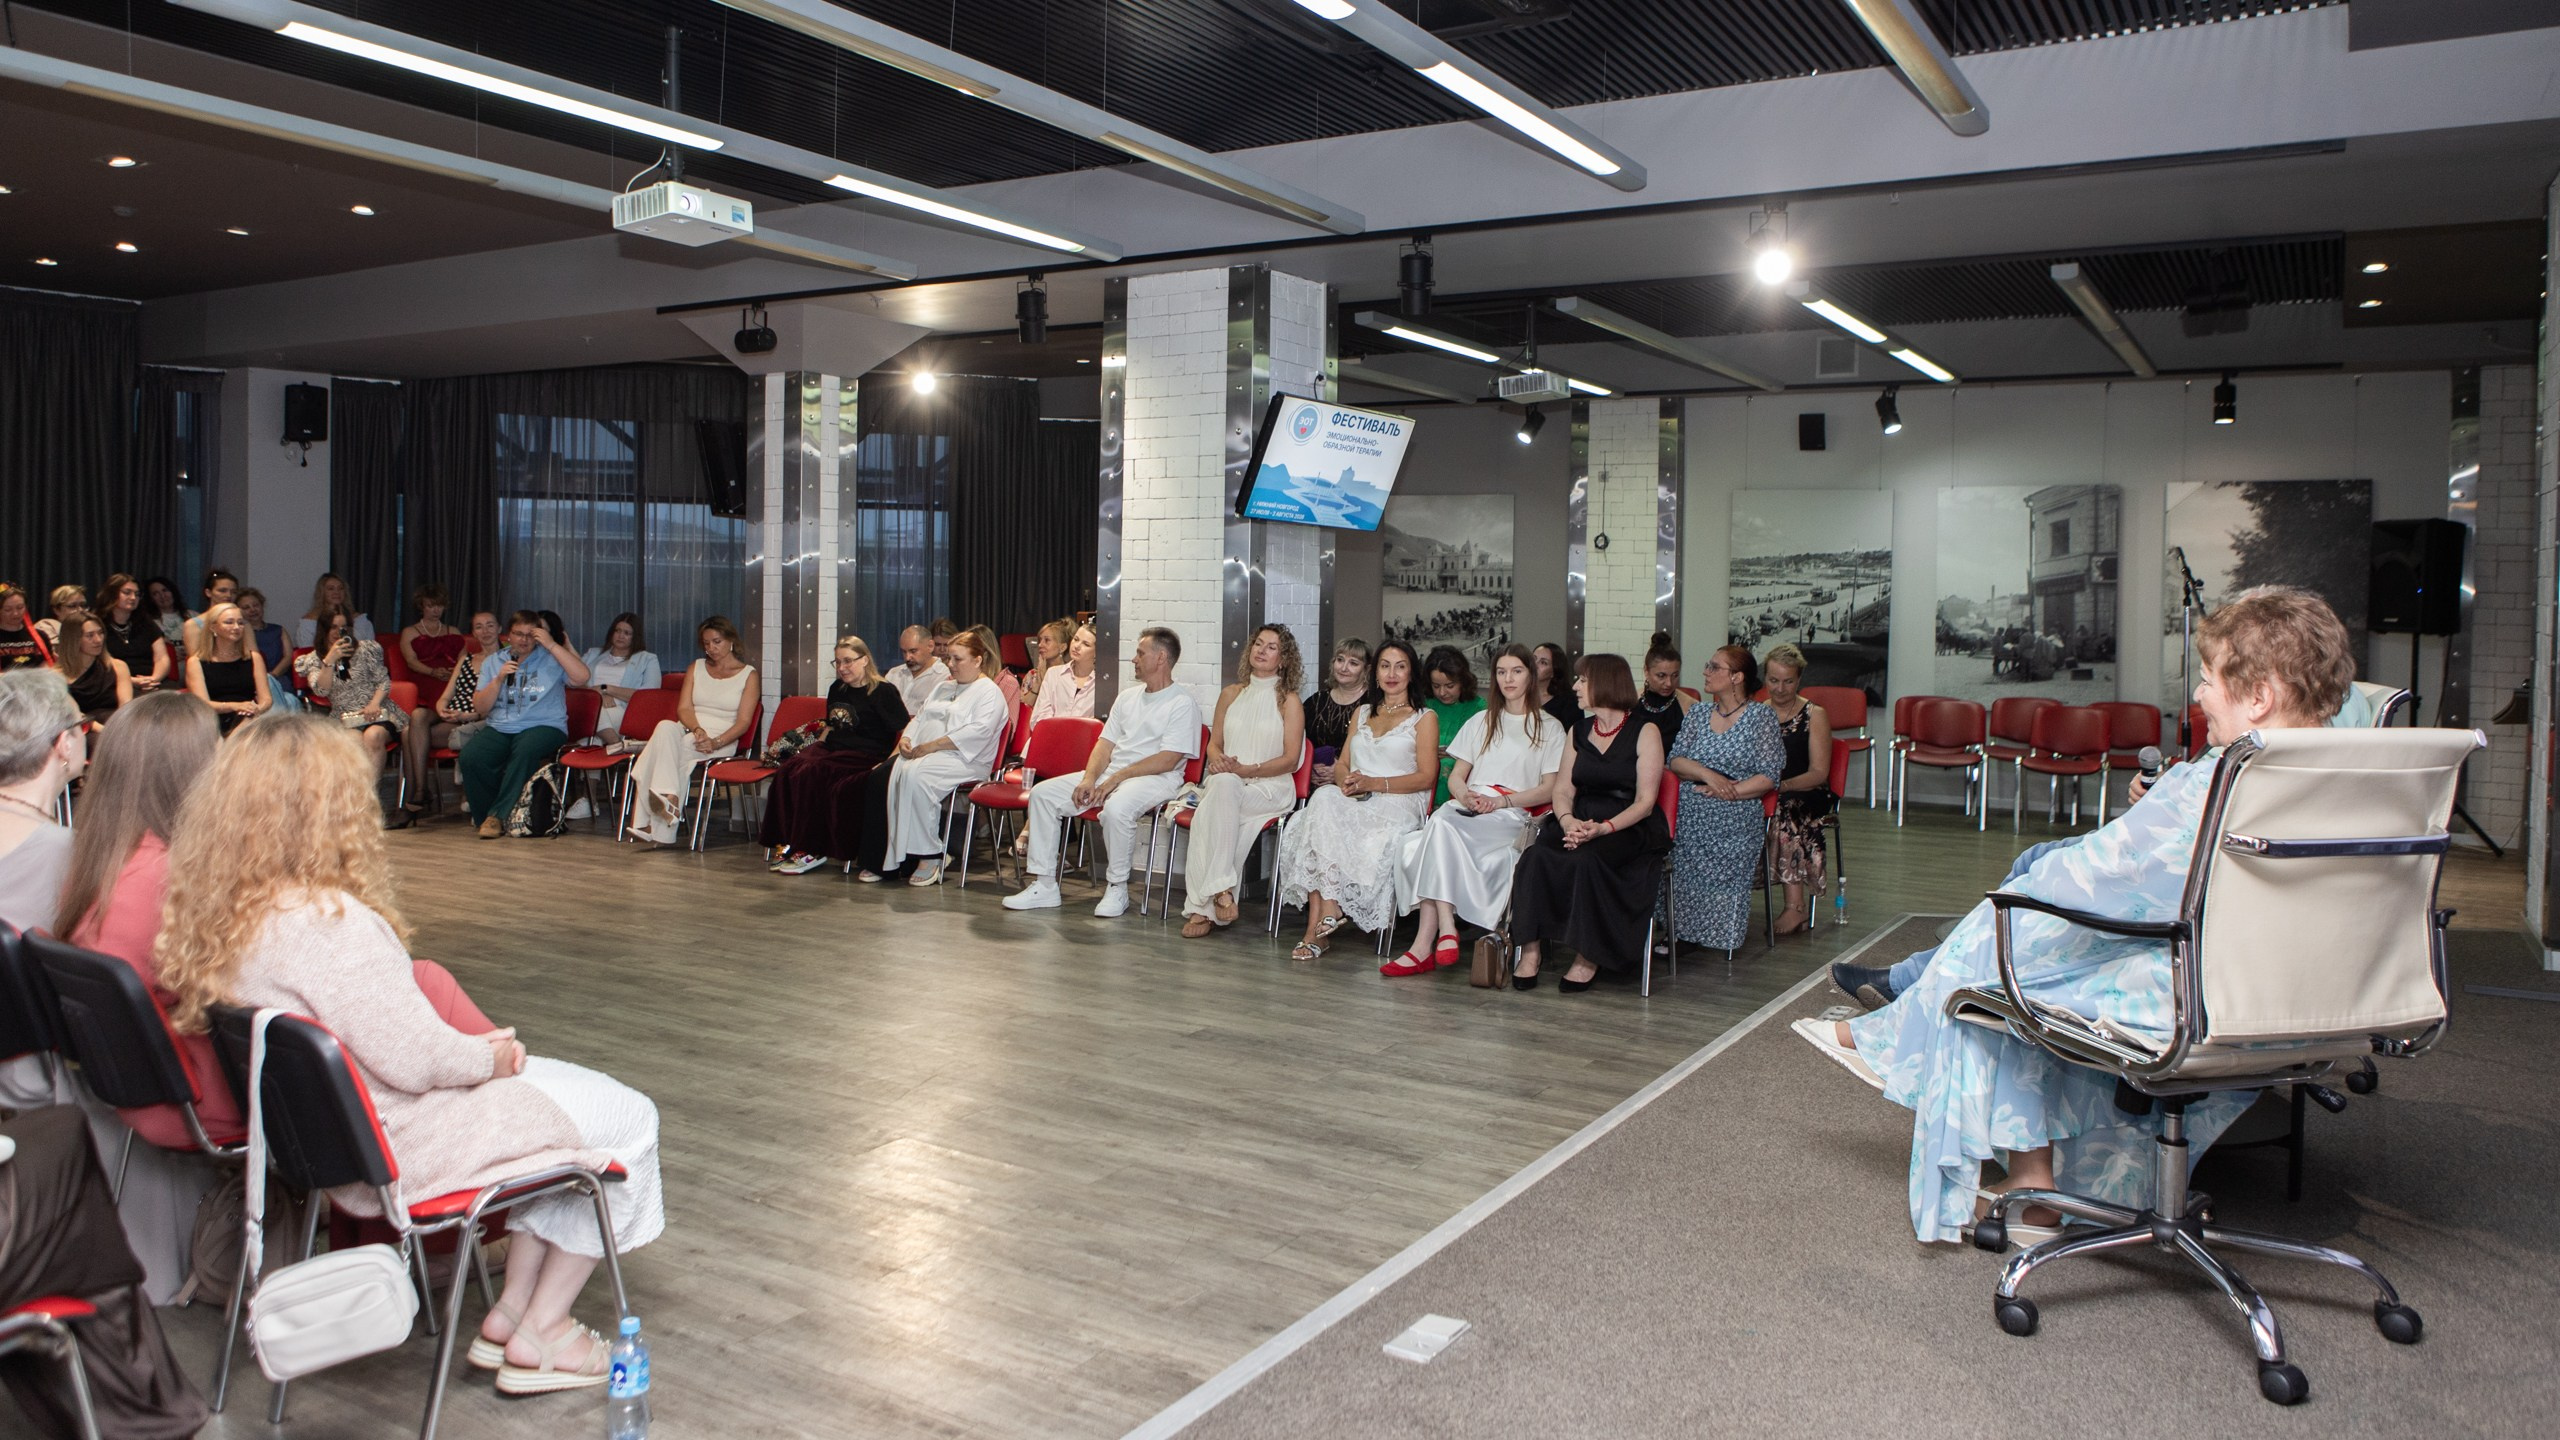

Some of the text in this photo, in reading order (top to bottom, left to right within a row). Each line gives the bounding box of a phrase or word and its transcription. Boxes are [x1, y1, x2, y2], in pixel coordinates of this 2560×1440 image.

[1299, 416, 1314, 426] ЭОТ
[1331, 411, 1401, 437] ФЕСТИВАЛЬ
[1326, 431, 1380, 447] ЭМОЦИОНАЛЬНО-
[1323, 441, 1382, 457] ОБРАЗНОЙ ТЕРАПИИ
[1276, 504, 1300, 512] НОВГОРОД
[1275, 511, 1294, 519] АВГУСТА
